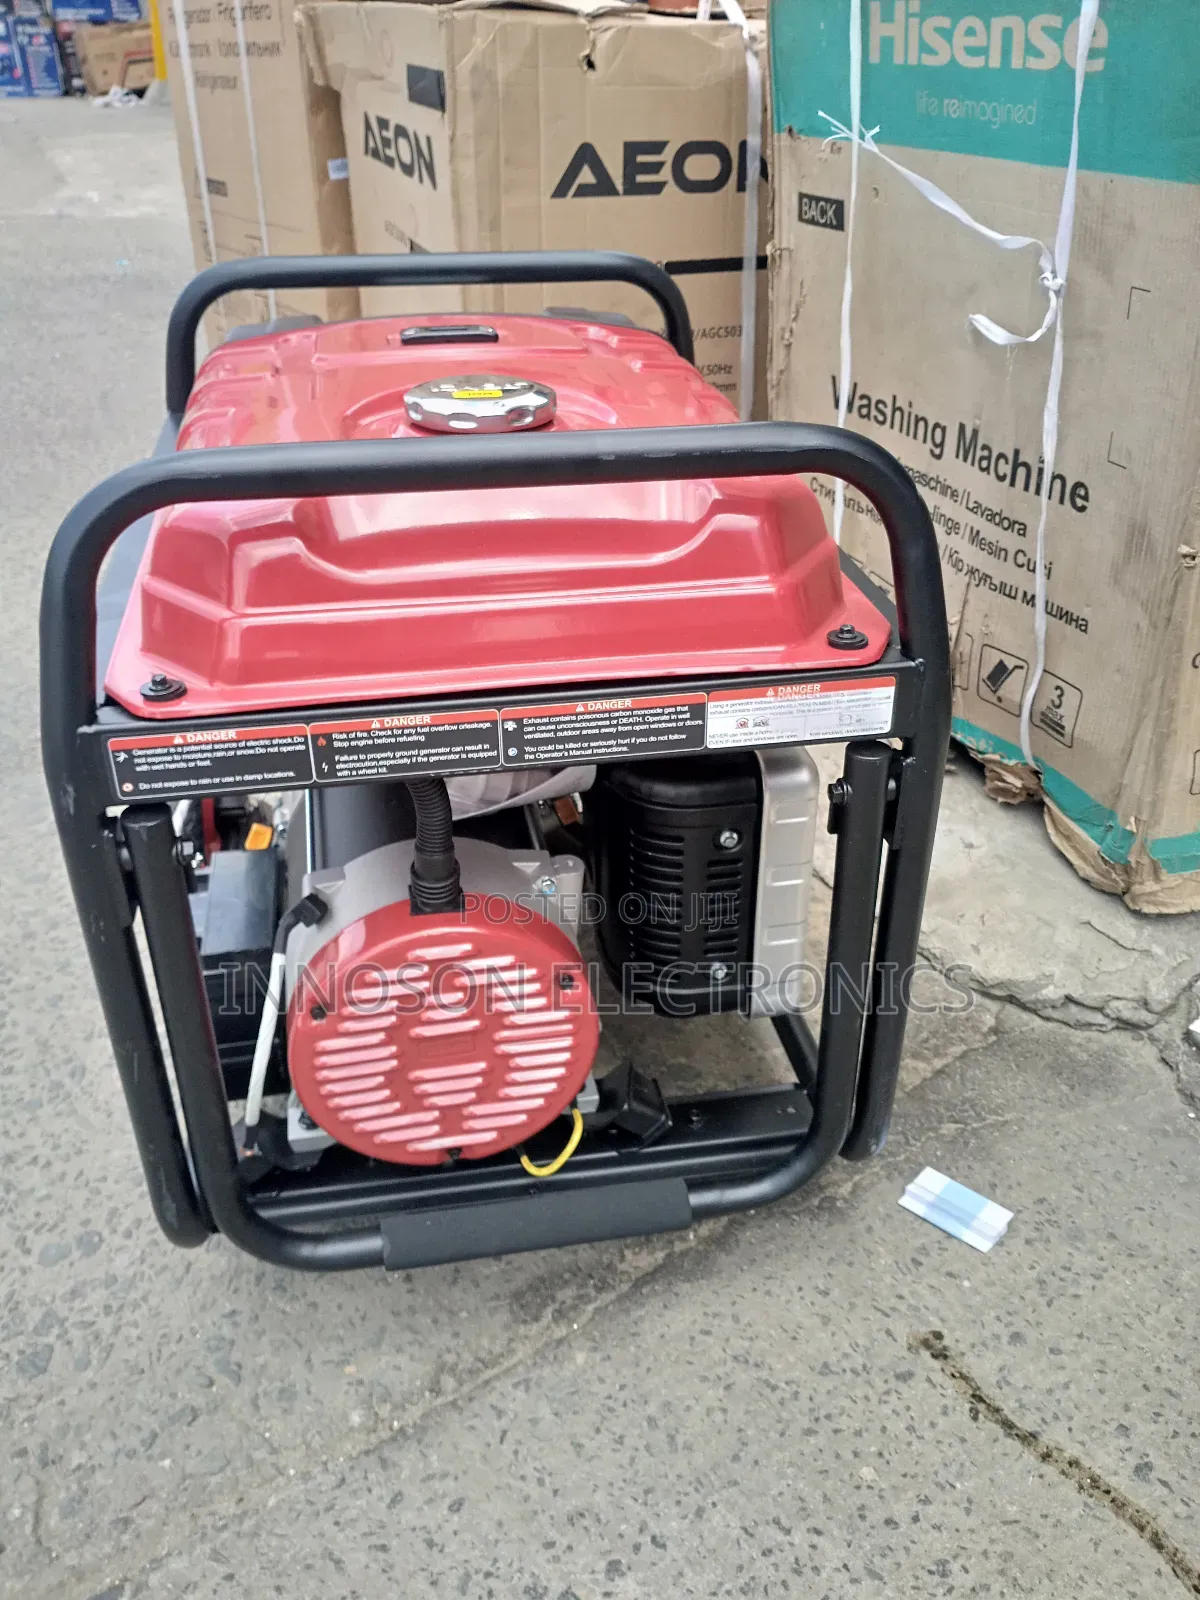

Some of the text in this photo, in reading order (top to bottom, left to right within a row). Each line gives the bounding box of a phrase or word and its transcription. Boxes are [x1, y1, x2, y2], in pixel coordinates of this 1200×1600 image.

[868, 0, 1109, 72] Hisense
[915, 90, 1038, 129] life reimagined
[363, 111, 437, 191] AEON
[800, 198, 837, 226] BACK
[831, 375, 1091, 513] Washing Machine
[965, 491, 1028, 538] Lavadora
[967, 525, 1008, 563] Mesin
[1013, 549, 1053, 581] Cui
[1021, 590, 1089, 635] мшина
[778, 684, 821, 695] DANGER
[1051, 684, 1065, 710] 3
[587, 699, 632, 711] DANGER
[384, 716, 432, 727] DANGER
[522, 716, 549, 725] Exhaust
[550, 714, 576, 722] contains
[577, 712, 610, 722] poisonous
[610, 710, 632, 718] carbon
[632, 708, 664, 716] monoxide
[536, 724, 556, 732] cause
[556, 720, 610, 730] unconsciousness
[618, 716, 644, 724] DEATH.
[186, 731, 237, 743] DANGER
[332, 732, 348, 740] Risk
[370, 728, 392, 738] Check
[430, 724, 458, 732] overflow
[524, 732, 556, 740] ventilated,
[556, 729, 581, 737] outdoor
[600, 726, 618, 734] away
[633, 724, 650, 732] open
[333, 740, 350, 748] Stop
[350, 739, 374, 747] engine
[396, 734, 425, 742] refueling
[538, 744, 555, 752] could
[590, 739, 617, 747] seriously
[658, 734, 668, 742] not
[335, 754, 358, 762] Failure
[366, 751, 394, 760] properly
[394, 748, 418, 758] ground
[419, 746, 450, 756] generator
[428, 752, 460, 763] generator
[468, 750, 498, 760] equipped
[524, 746, 630, 760] the Operator's Manual instructions.
[336, 769, 351, 777] with
[138, 782, 151, 791] Do
